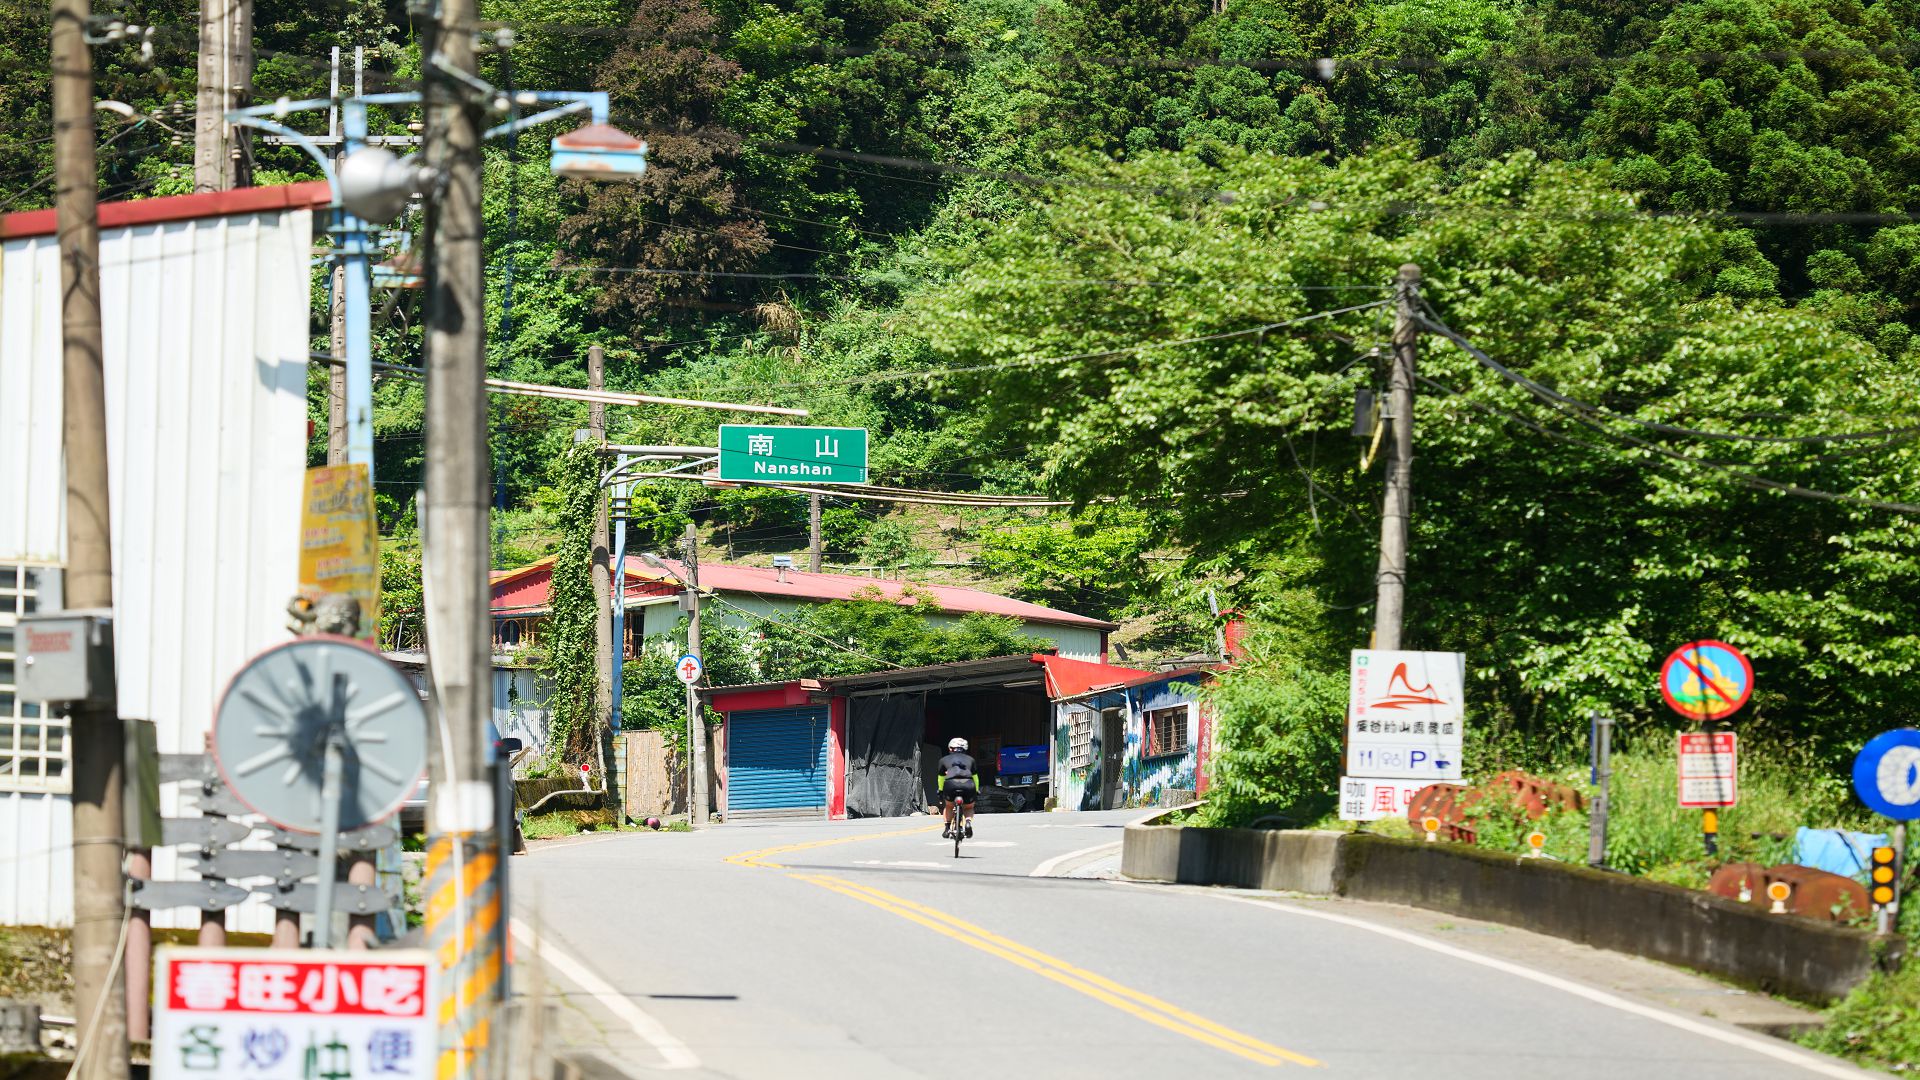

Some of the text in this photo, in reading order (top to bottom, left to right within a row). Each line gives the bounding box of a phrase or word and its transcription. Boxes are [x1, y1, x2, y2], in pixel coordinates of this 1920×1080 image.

[747, 434, 839, 458] 南山
[754, 461, 832, 476] Nanshan
[1410, 751, 1427, 769] P
[1346, 783, 1366, 817] 咖啡
[175, 961, 423, 1016] 春旺小吃
